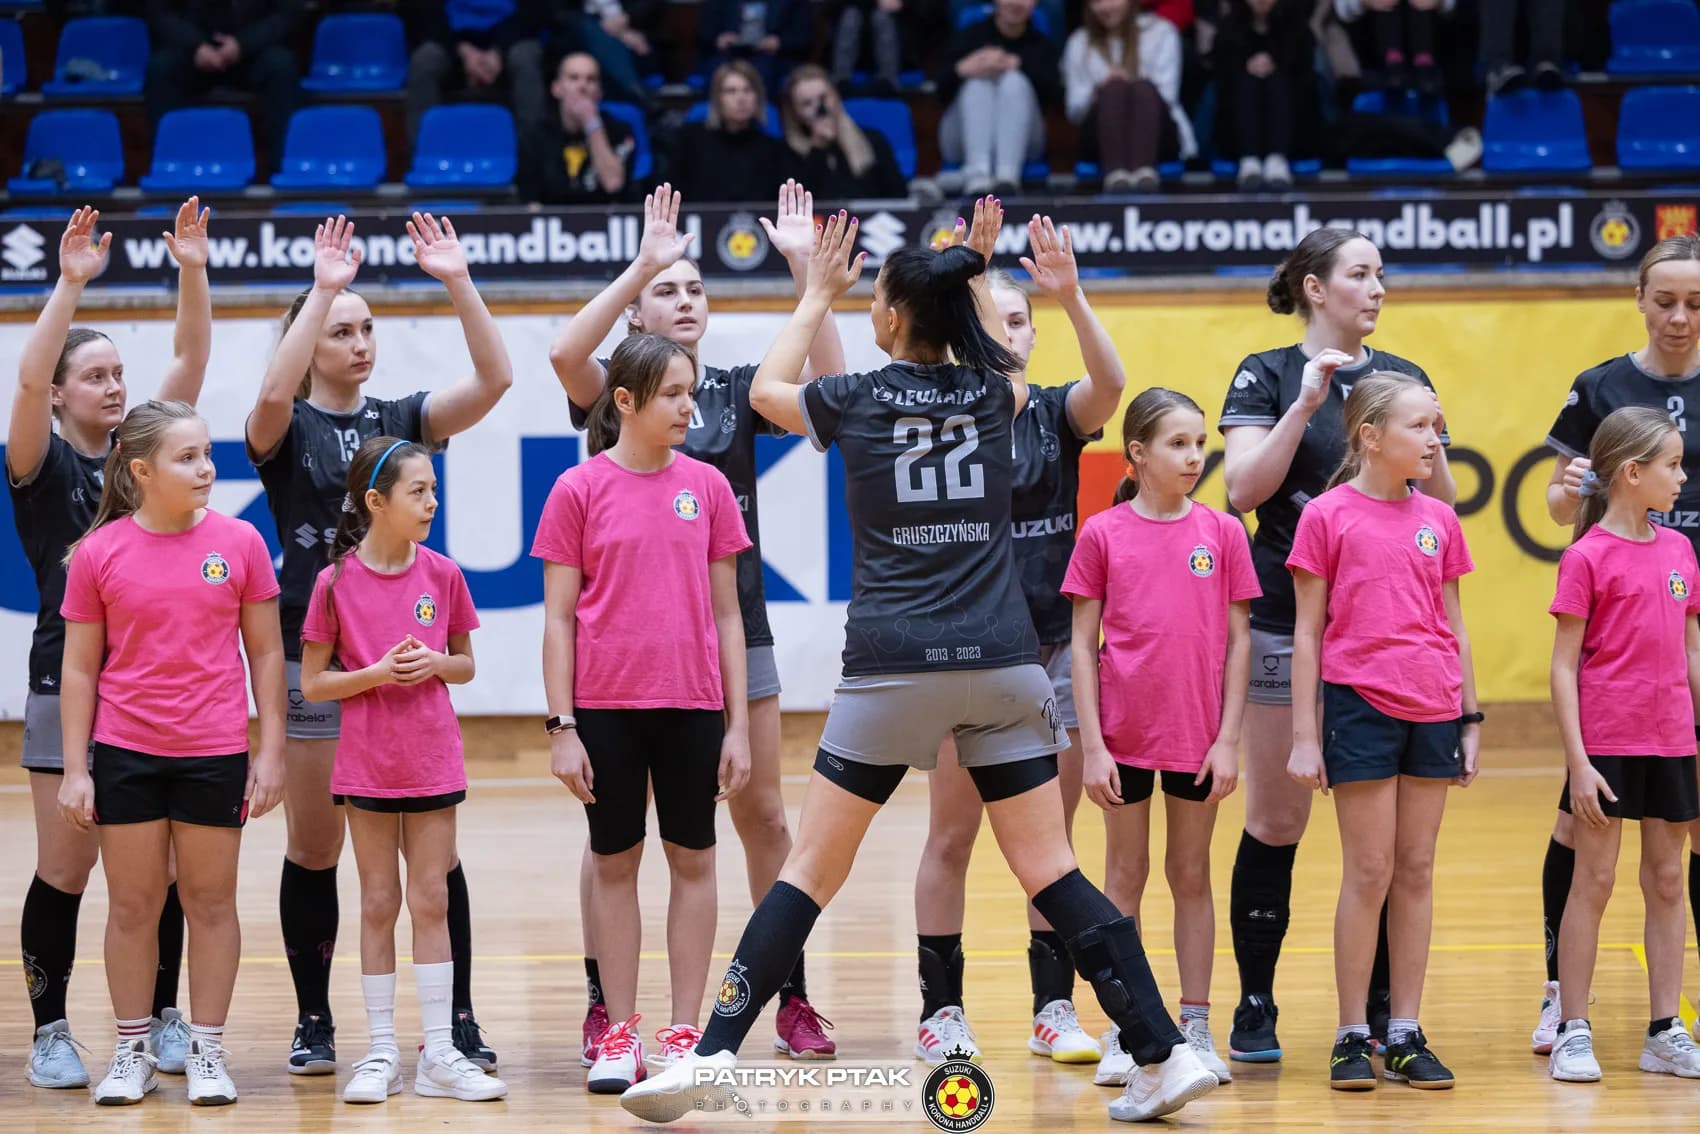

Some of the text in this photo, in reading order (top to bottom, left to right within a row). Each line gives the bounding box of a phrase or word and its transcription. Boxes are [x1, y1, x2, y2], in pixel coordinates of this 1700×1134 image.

[1667, 395, 1687, 432] 2
[334, 428, 360, 462] 13
[893, 414, 985, 502] 22
[892, 519, 990, 545] GRUSZCZYŃSKA
[925, 647, 949, 661] 2013
[956, 645, 981, 660] 2023
